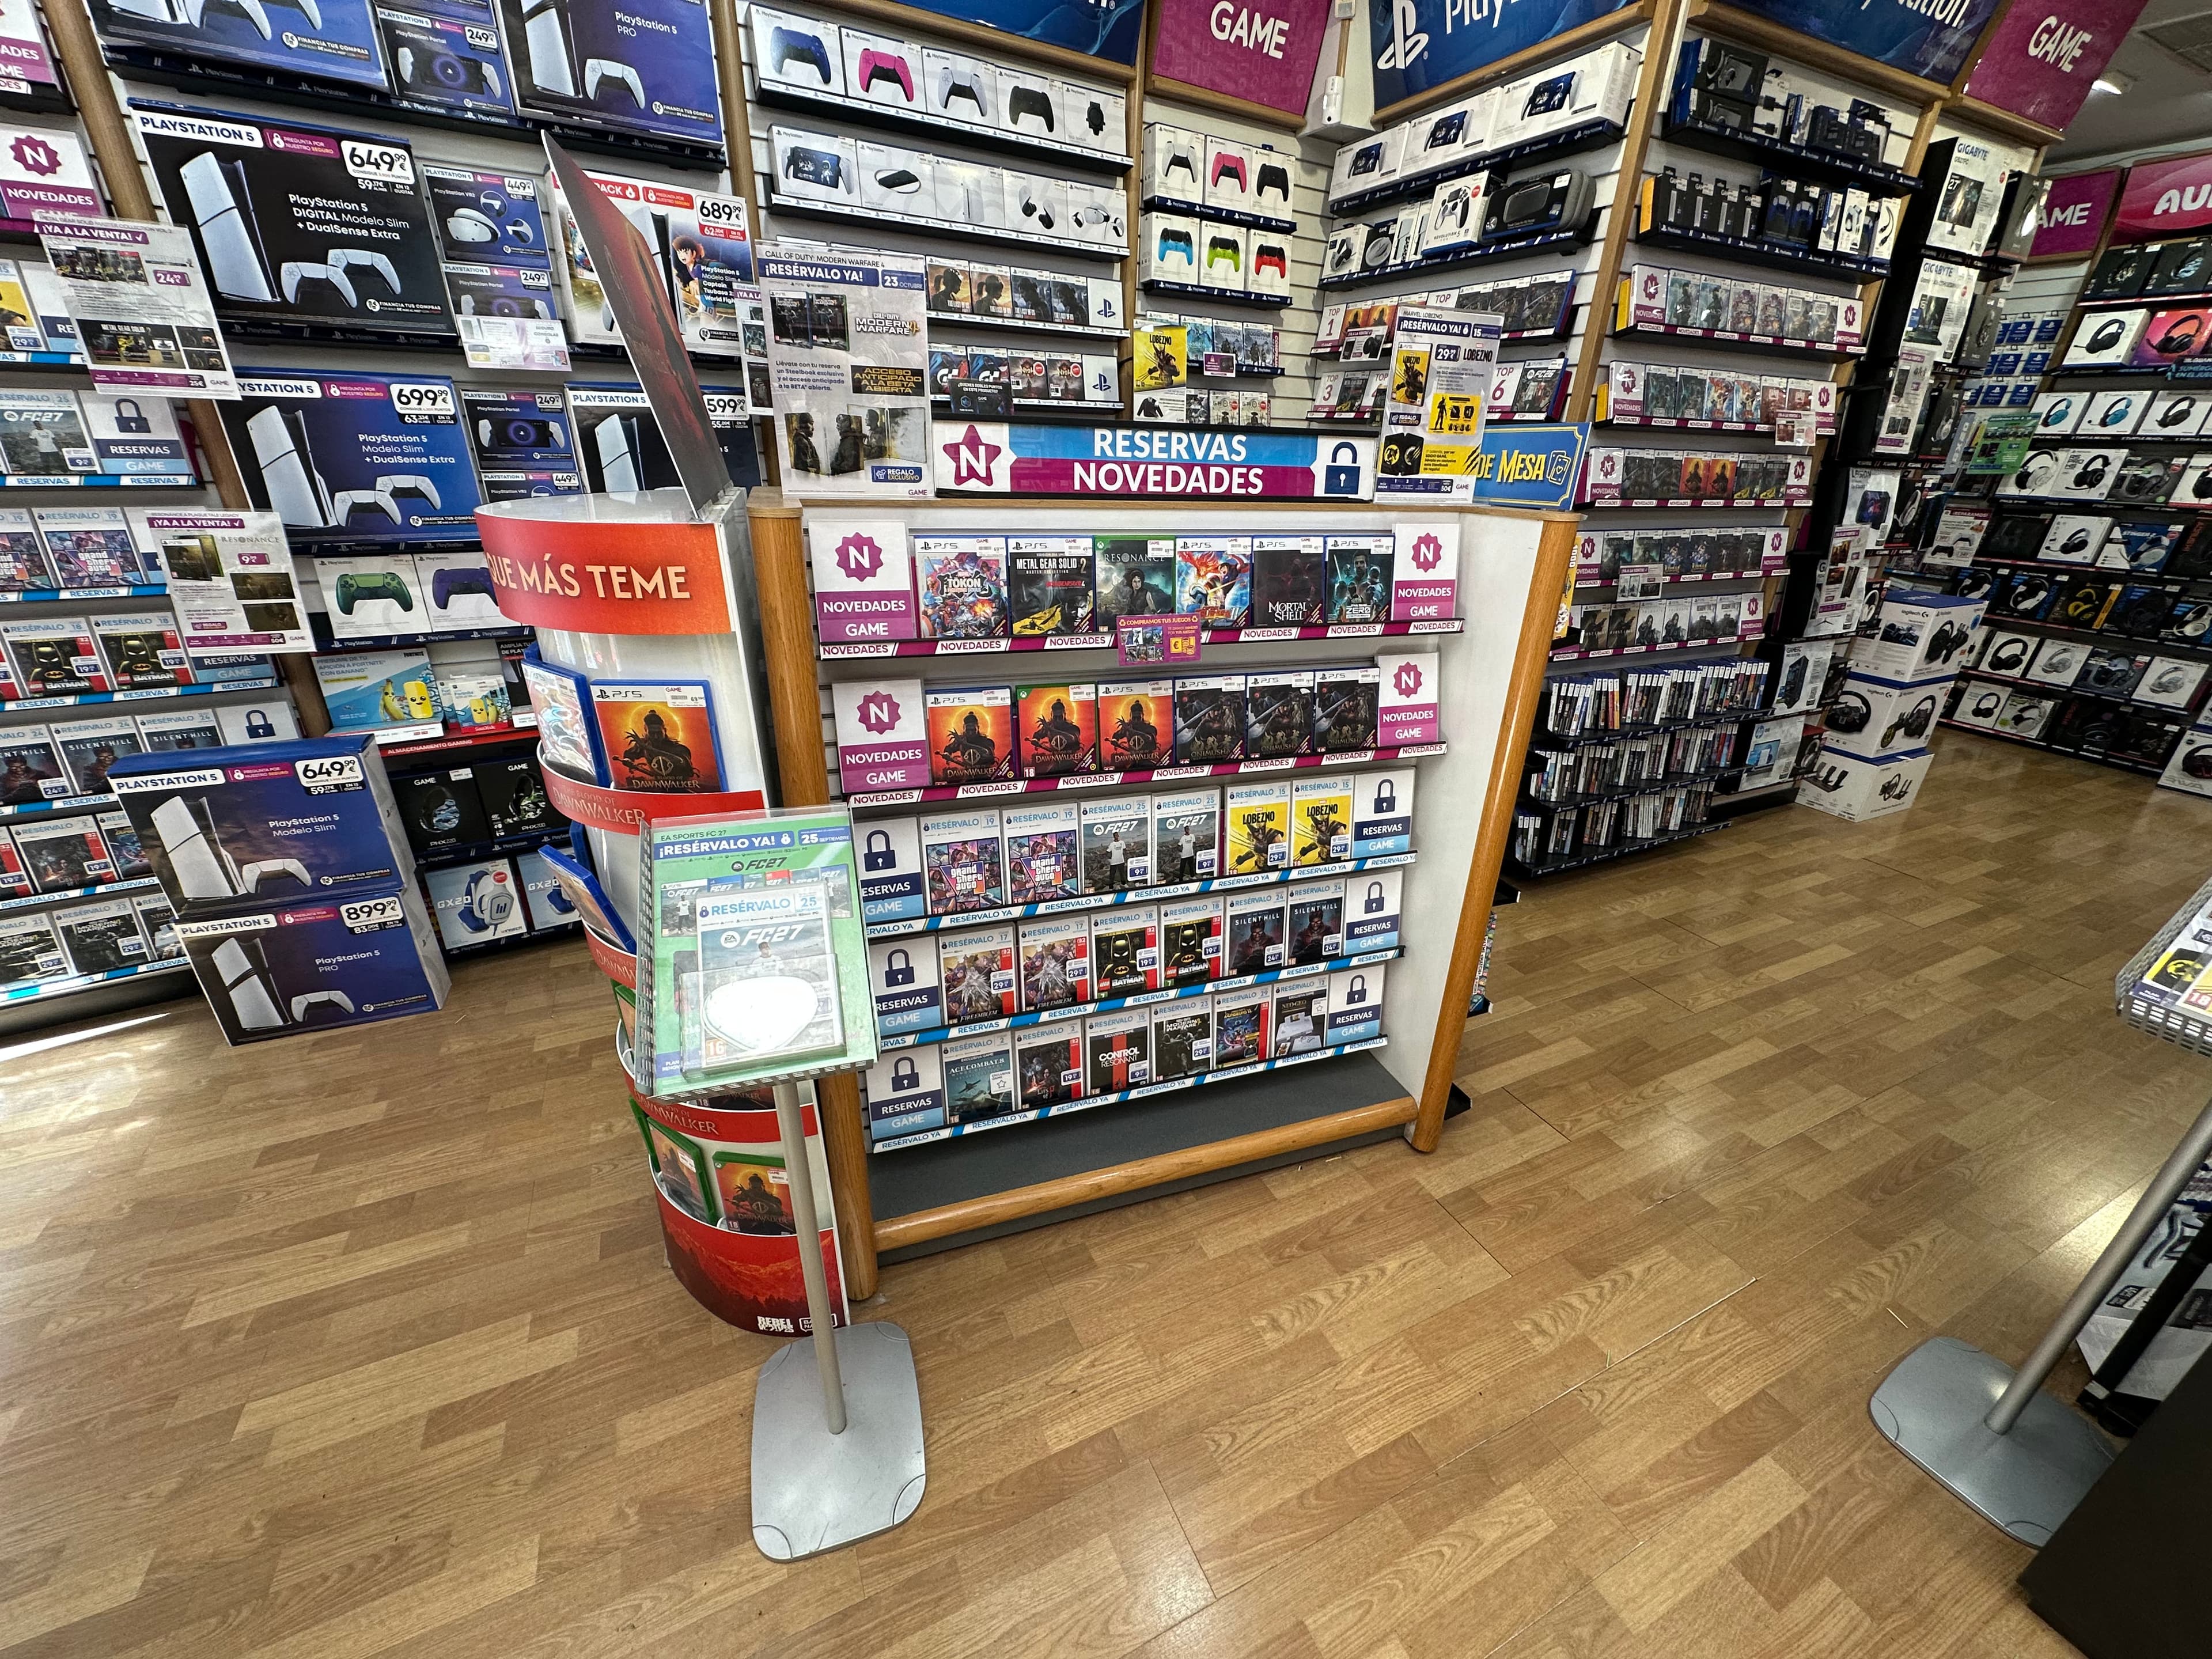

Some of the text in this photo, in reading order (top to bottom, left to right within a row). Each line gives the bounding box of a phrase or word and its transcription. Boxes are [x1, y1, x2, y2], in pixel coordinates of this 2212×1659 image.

[615, 11, 678, 34] PlayStation 5
[617, 25, 636, 37] PRO
[1210, 0, 1290, 60] GAME
[299, 36, 327, 47] FINANCIA
[340, 44, 369, 55] COMPRAS
[2027, 15, 2093, 73] GAME
[141, 116, 255, 142] PLAYSTATION 5
[1957, 143, 1988, 161] GIGABYTE
[6, 188, 94, 206] NOVEDADES
[289, 194, 358, 211] PlayStation
[293, 207, 410, 229] DIGITAL Modelo Slim
[2037, 203, 2092, 228] AME
[306, 222, 400, 240] DualSense Extra
[795, 253, 815, 262] DUTY:
[817, 255, 847, 264] MODERN
[849, 259, 880, 267] WARFARE
[701, 266, 734, 275] PlayStation
[766, 263, 863, 282] ¡RESÉRVALO YA!
[884, 276, 897, 286] 23
[1328, 308, 1340, 316] TOP
[1327, 319, 1334, 336] 1
[1400, 320, 1461, 334] ¡RESÉRVALO YA!
[1474, 329, 1481, 337] 15
[1464, 349, 1493, 362] LOBEZNO
[854, 373, 921, 381] ANTICIPADO
[1497, 366, 1514, 377] TOP
[1613, 402, 1641, 412] NOVEDADES
[20, 412, 63, 422] FC27
[358, 434, 418, 442] PlayStation
[110, 446, 170, 454] RESERVAS
[362, 445, 400, 453] Modelo
[1093, 429, 1247, 462] RESERVAS
[374, 455, 455, 464] DualSense Extra
[887, 468, 914, 476] REGALO
[1073, 462, 1264, 495] NOVEDADES
[908, 488, 927, 497] GAME
[1592, 487, 1620, 495] NOVEDADES
[45, 511, 100, 520] RESÉRVALO
[849, 546, 870, 569] N
[1016, 558, 1087, 573] METAL GEAR SOLID 2
[518, 552, 581, 598] MÁS
[586, 565, 691, 600] TEME
[1397, 587, 1452, 598] NOVEDADES
[823, 600, 906, 613] NOVEDADES
[1268, 601, 1308, 613] MORTAL
[1410, 605, 1438, 617] GAME
[1274, 611, 1305, 623] SHELL
[845, 622, 888, 636] GAME
[941, 640, 1001, 652] NOVEDADES
[612, 690, 643, 698] PS5
[1382, 710, 1434, 722] NOVEDADES
[388, 742, 446, 754] ALMACENAMIENTO
[1402, 744, 1443, 753] NOVEDADES
[846, 749, 922, 764] NOVEDADES
[1036, 753, 1082, 763] DAWNWALKER
[508, 763, 528, 771] GAME
[1025, 768, 1034, 777] 18
[116, 775, 207, 790] PLAYSTATION
[414, 777, 436, 786] GAME
[268, 816, 331, 828] PlayStation
[931, 817, 995, 831] RESÉRVALO 19
[1175, 814, 1207, 828] FC27
[1242, 812, 1275, 825] LOBEZNO
[1362, 823, 1403, 836] RESERVAS
[673, 832, 704, 840] SPORTS
[802, 834, 818, 844] 25
[659, 836, 775, 859] ¡RESÉRVALO YA!
[1369, 839, 1395, 850] GAME
[1030, 858, 1055, 869] grand
[1035, 865, 1061, 874] theft
[1035, 873, 1055, 882] auto
[711, 896, 817, 916] RESÉRVALO 25
[950, 909, 1013, 924] RESÉRVALO YA
[1234, 912, 1279, 926] SILENT HILL
[741, 923, 805, 946] FC27
[315, 953, 373, 965] PlayStation
[319, 964, 339, 972] PRO
[1112, 975, 1144, 987] BATMAN
[1048, 1005, 1088, 1018] RESERVAS
[707, 1041, 725, 1055] 16
[1099, 1047, 1140, 1062] CONTROL
[966, 1060, 998, 1070] COMBAT
[1101, 1054, 1138, 1069] RESONANT
[881, 1097, 932, 1115] RESERVAS
[728, 1221, 738, 1229] 18
[757, 1316, 793, 1325] REBEL
